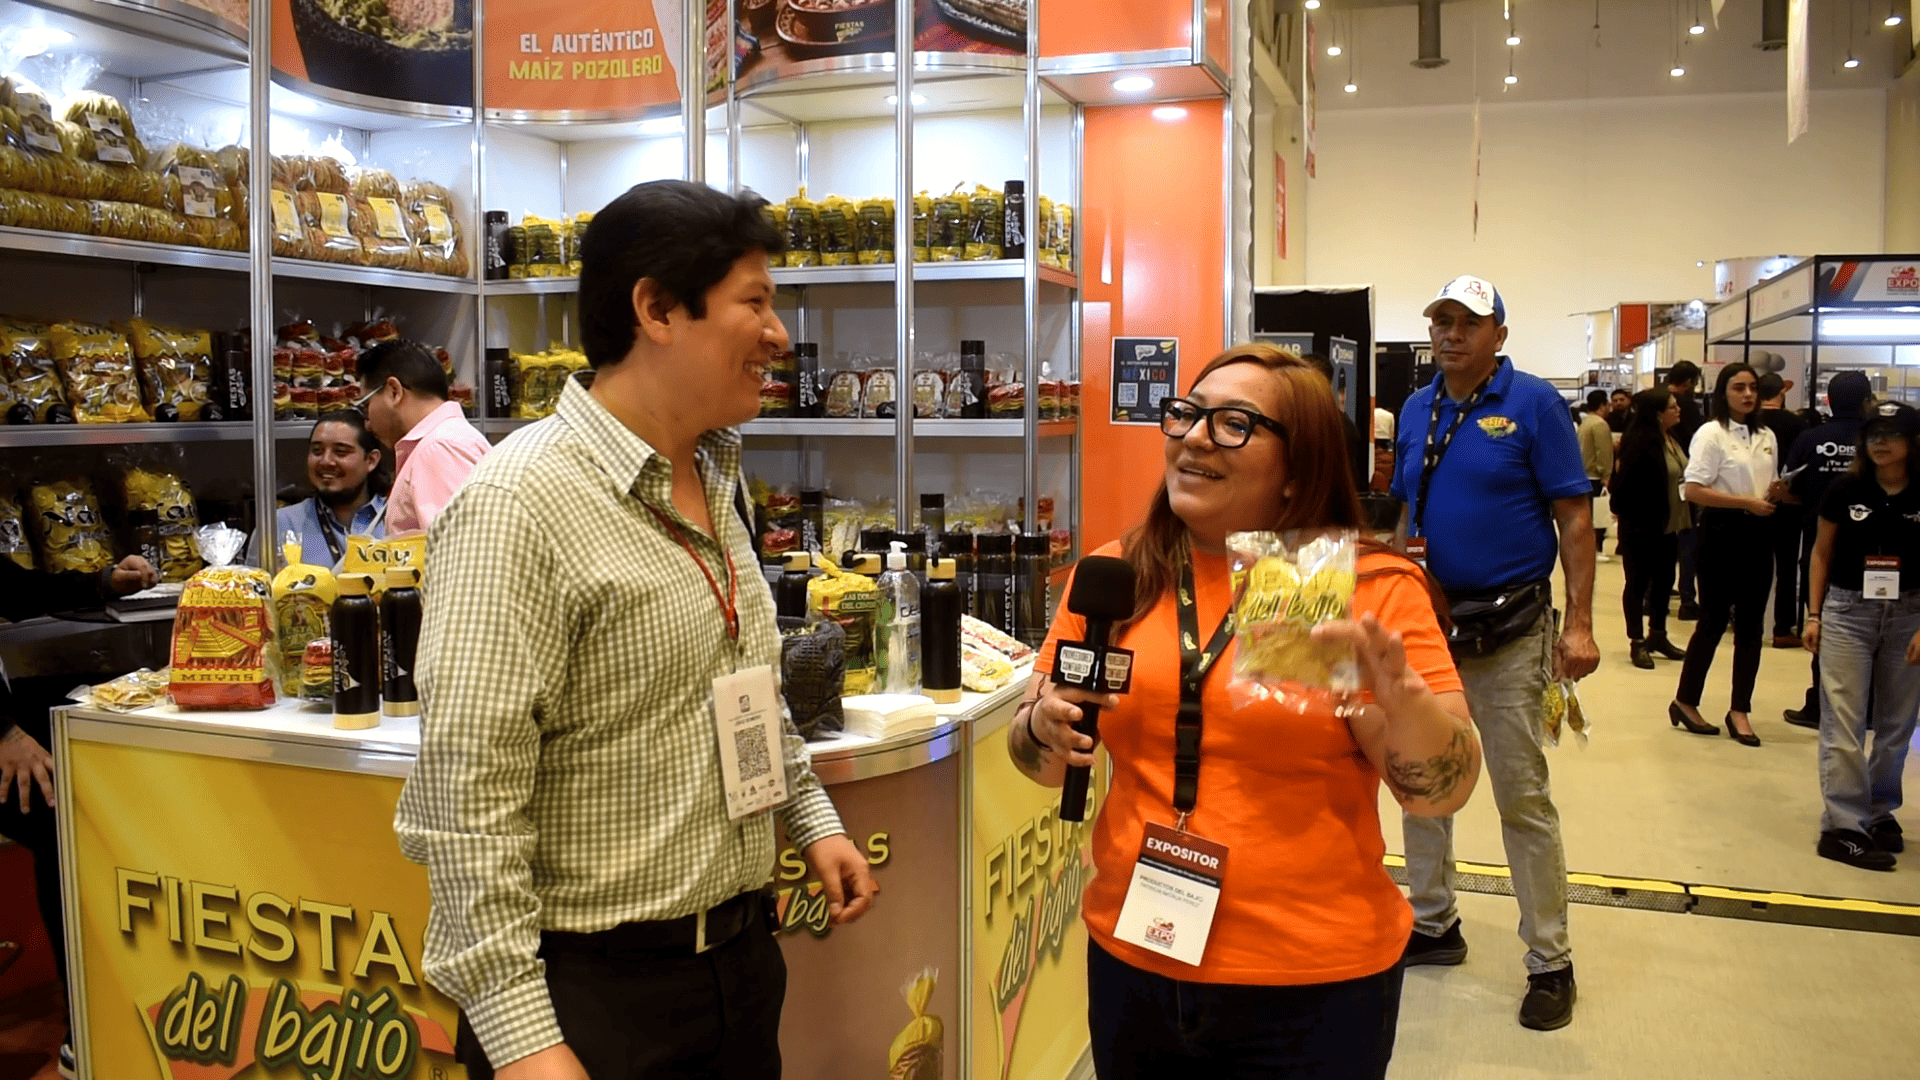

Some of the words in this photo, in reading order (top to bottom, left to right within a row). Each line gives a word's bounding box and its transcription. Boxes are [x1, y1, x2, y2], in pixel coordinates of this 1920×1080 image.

[520, 33, 542, 53] EL
[509, 56, 563, 80] MAÍZ
[572, 54, 662, 80] POZOLERO
[181, 673, 254, 682] MAYAS
[1146, 837, 1220, 870] EXPOSITOR
[115, 866, 418, 986] FIESTA
[1000, 899, 1033, 1001] del
[1037, 843, 1081, 951] bajío
[163, 977, 239, 1052] del
[264, 984, 409, 1080] bajío
